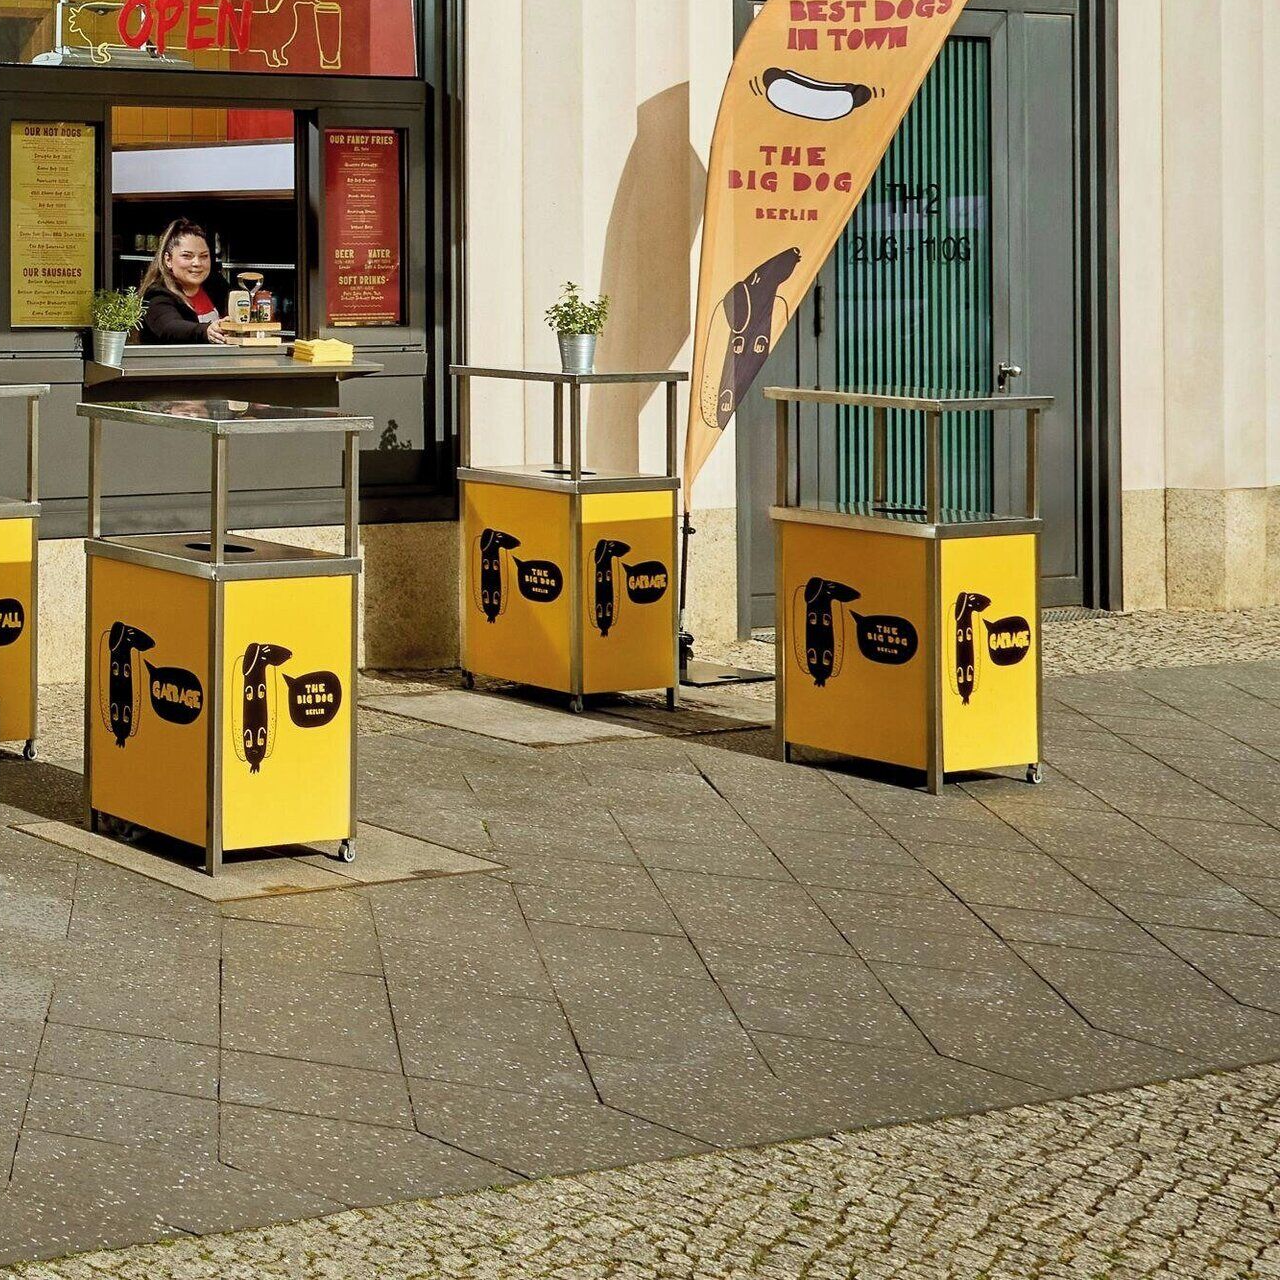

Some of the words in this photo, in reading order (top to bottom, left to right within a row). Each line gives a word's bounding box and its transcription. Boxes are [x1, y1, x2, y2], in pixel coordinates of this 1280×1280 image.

[790, 0, 866, 22] BEST
[787, 28, 818, 51] IN
[827, 26, 908, 51] TOWN
[24, 126, 41, 136] OUR
[43, 127, 59, 137] HOT
[61, 128, 82, 137] DOGS
[329, 135, 345, 144] OUR
[347, 135, 370, 144] FANCY
[371, 136, 393, 145] FRIES
[759, 145, 826, 166] THE
[728, 170, 778, 192] BIG
[793, 171, 852, 193] DOG
[756, 208, 818, 221] BERLIN
[335, 249, 355, 259] BEER
[368, 249, 391, 258] WATER
[22, 267, 39, 277] OUR
[41, 267, 82, 277] SAUSAGES
[339, 275, 358, 285] SOFT
[531, 568, 548, 577] THE
[525, 575, 538, 584] BIG
[628, 574, 667, 590] GARBAGE
[876, 624, 898, 635] THE
[867, 632, 884, 642] BIG
[888, 635, 908, 647] DOG
[989, 630, 1029, 650] GARBAGE
[152, 680, 201, 709] GARBAGE
[305, 683, 326, 694] THE
[297, 694, 313, 705] BIG
[315, 693, 333, 703] DOG
